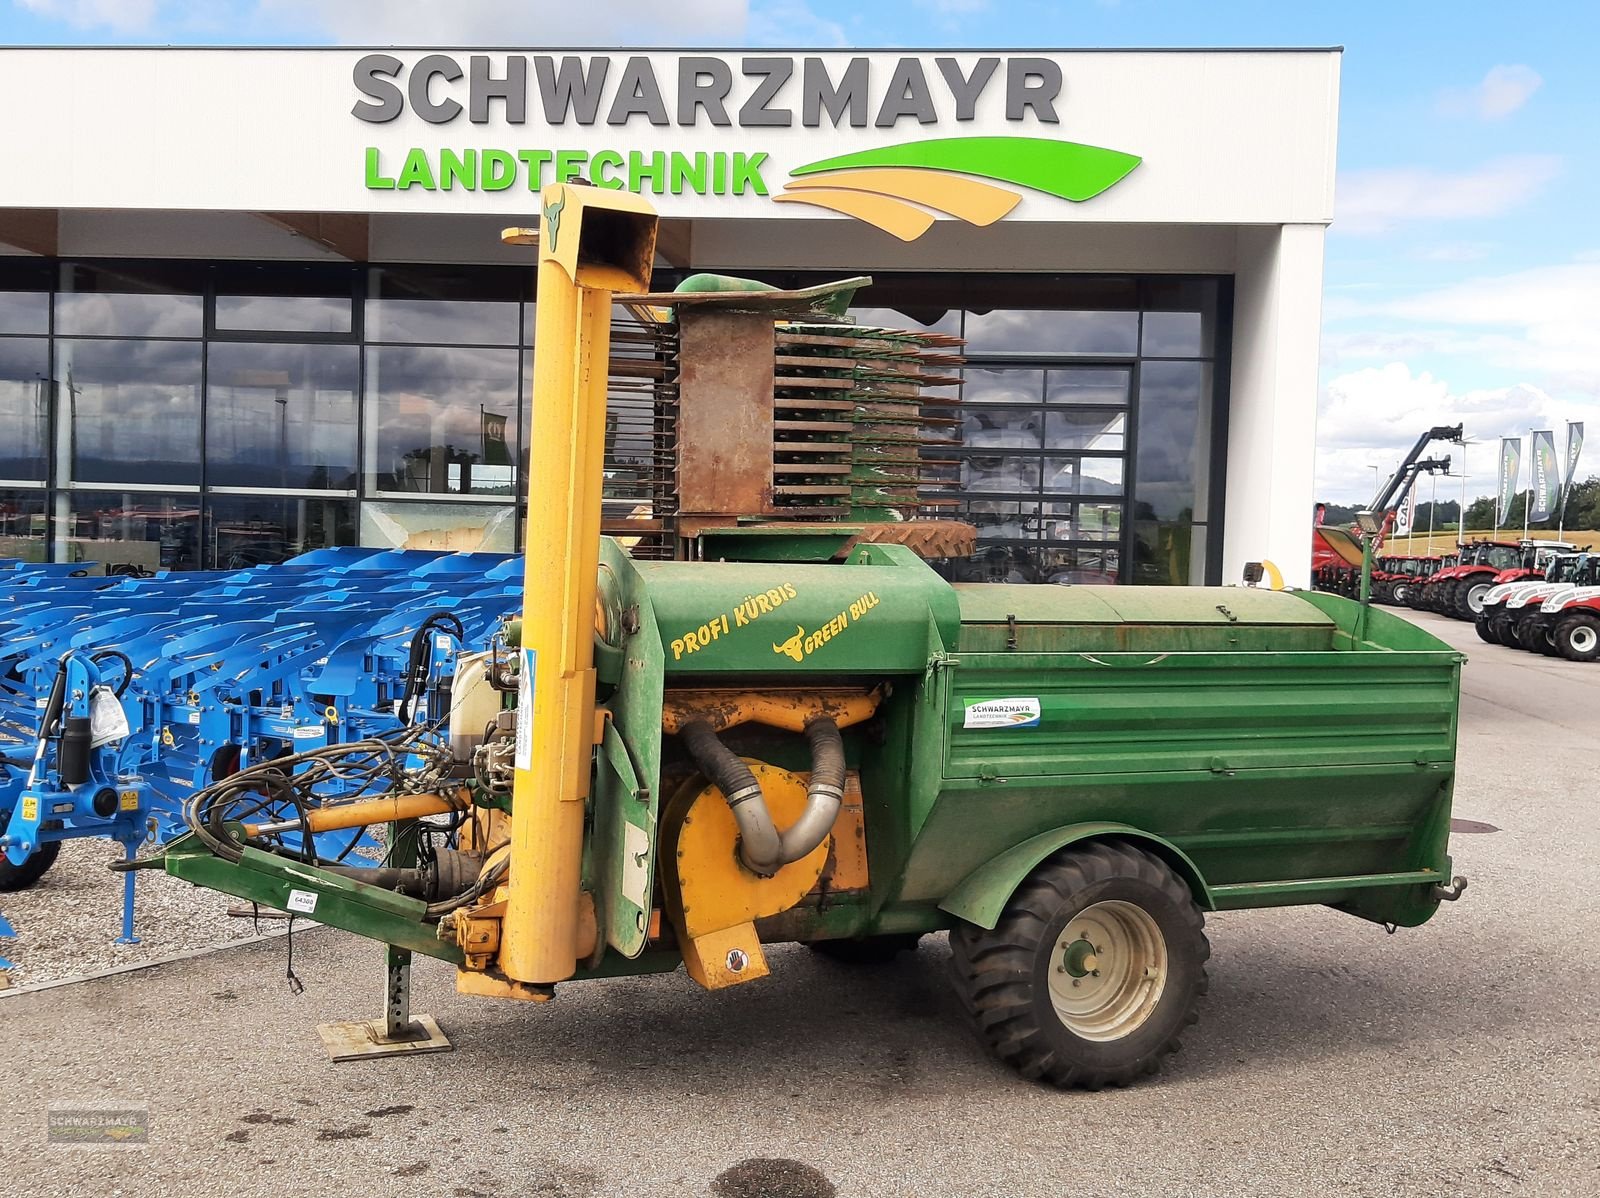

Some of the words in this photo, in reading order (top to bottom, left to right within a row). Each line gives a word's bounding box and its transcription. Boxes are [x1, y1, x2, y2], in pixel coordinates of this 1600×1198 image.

[350, 53, 1063, 128] SCHWARZMAYR
[364, 146, 769, 195] LANDTECHNIK
[1400, 491, 1410, 527] CAS
[1536, 449, 1547, 513] SCHWARZMAYR
[670, 614, 729, 660] PROFI
[733, 582, 798, 627] KÜRBIS
[804, 611, 849, 655] GREEN
[849, 591, 881, 621] BULL
[972, 705, 1031, 713] SCHWARZMAYR
